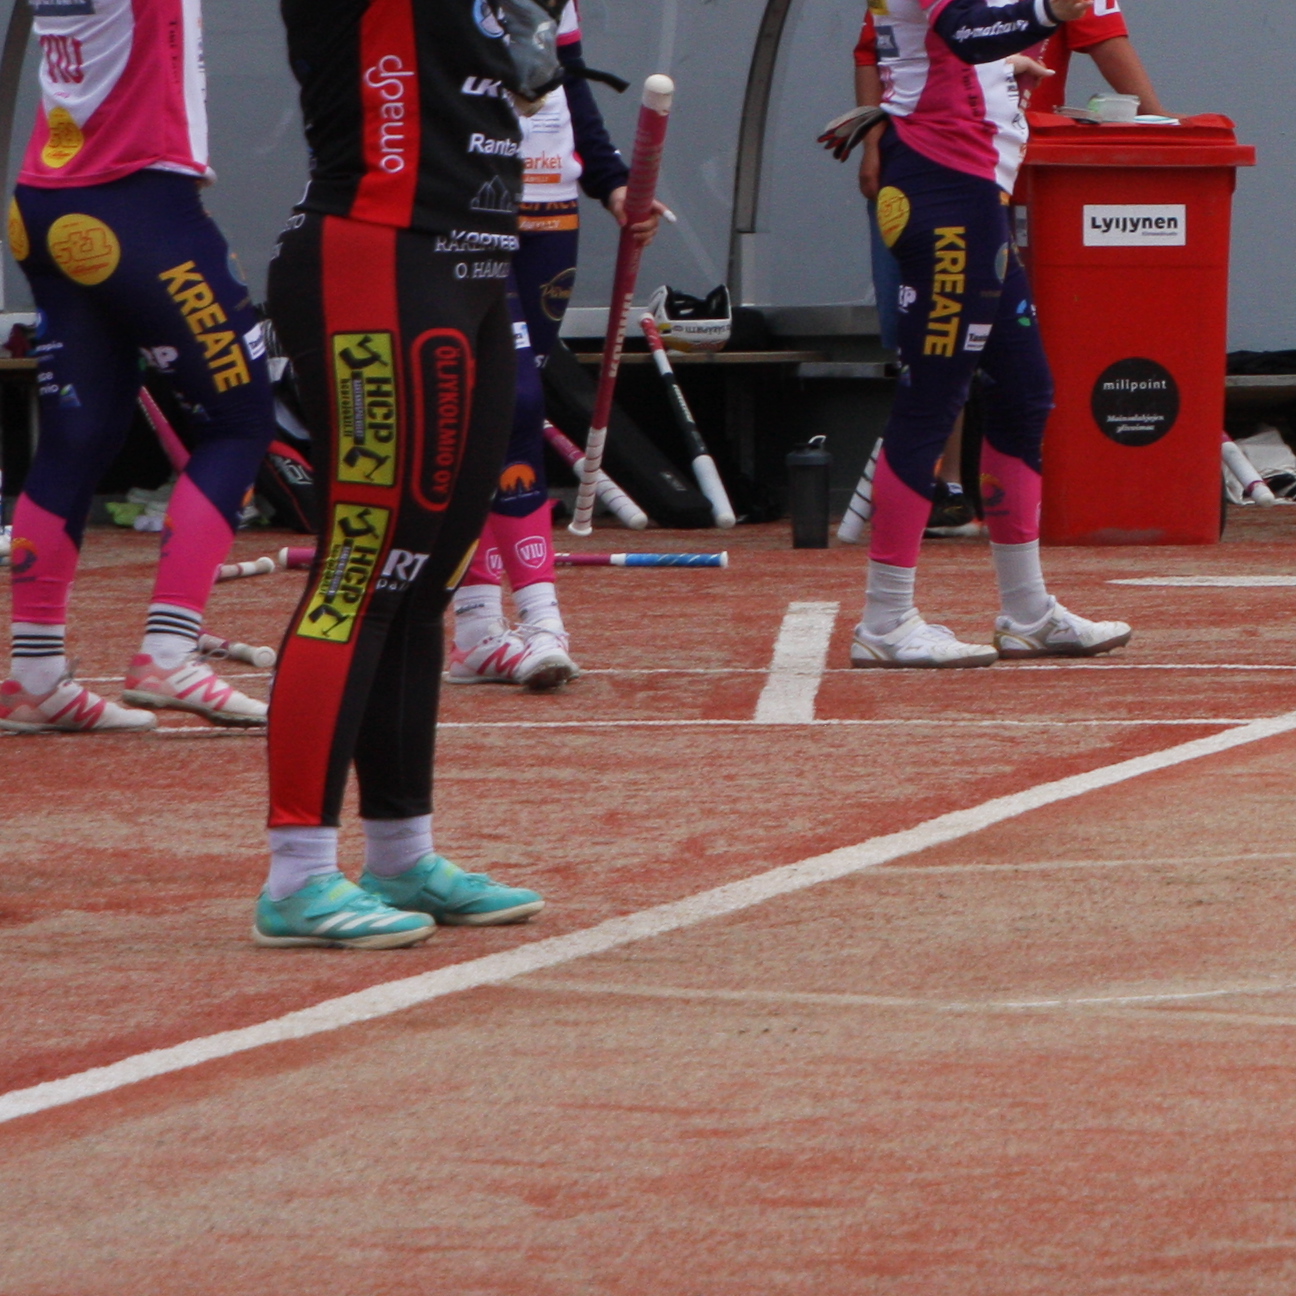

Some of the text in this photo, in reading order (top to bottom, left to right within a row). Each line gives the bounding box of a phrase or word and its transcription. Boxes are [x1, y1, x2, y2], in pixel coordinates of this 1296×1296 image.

[524, 150, 563, 169] arket
[923, 226, 967, 358] KREATE
[158, 260, 251, 393] KREATE
[365, 376, 394, 444] HCP
[1103, 378, 1167, 393] millpoint
[340, 545, 379, 604] HCP
